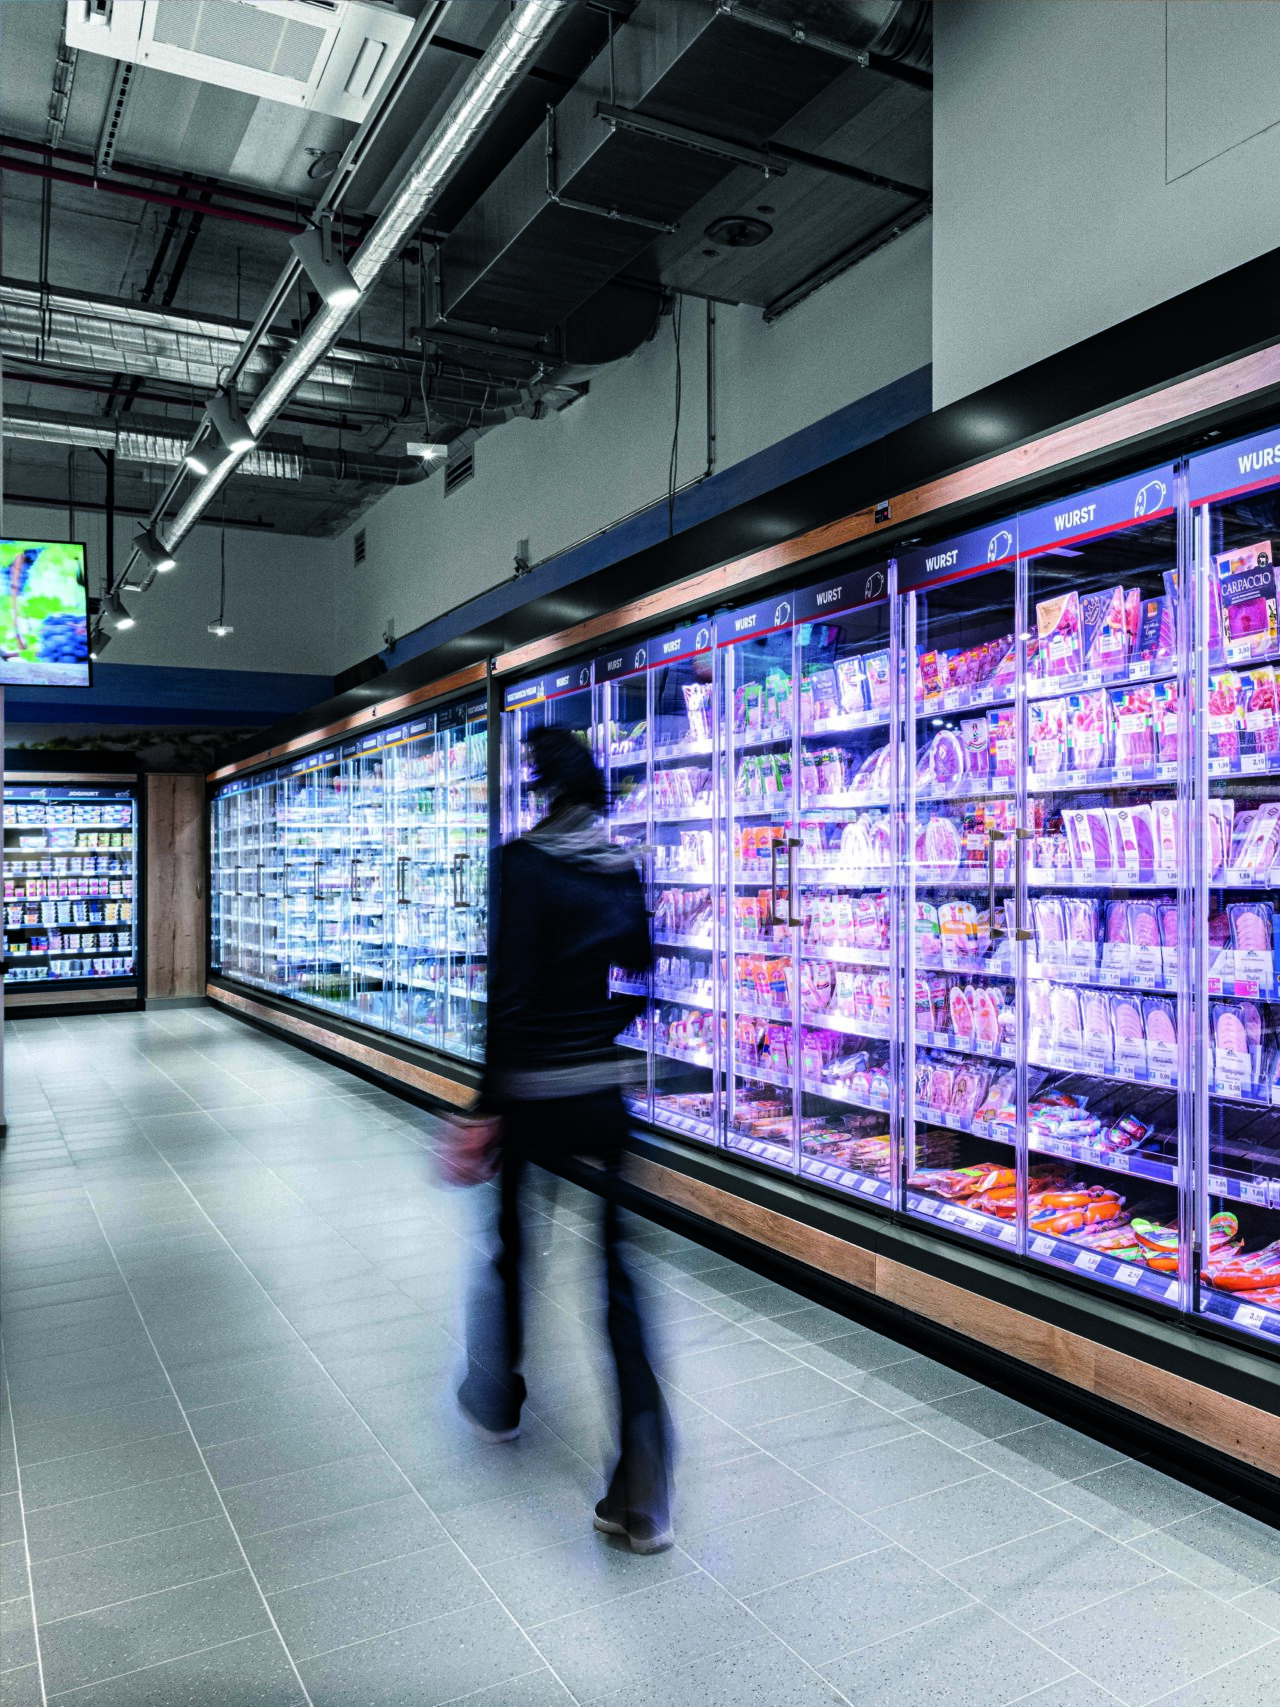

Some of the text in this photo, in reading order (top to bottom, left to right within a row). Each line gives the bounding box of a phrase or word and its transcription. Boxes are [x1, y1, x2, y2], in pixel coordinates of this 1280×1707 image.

[1054, 504, 1096, 532] WURST
[925, 550, 958, 572] WURST
[1221, 572, 1271, 597] CARPACCIO
[816, 586, 842, 606] WURST
[735, 614, 756, 632] WURST
[663, 638, 681, 654] WURST
[607, 658, 622, 671] WURST
